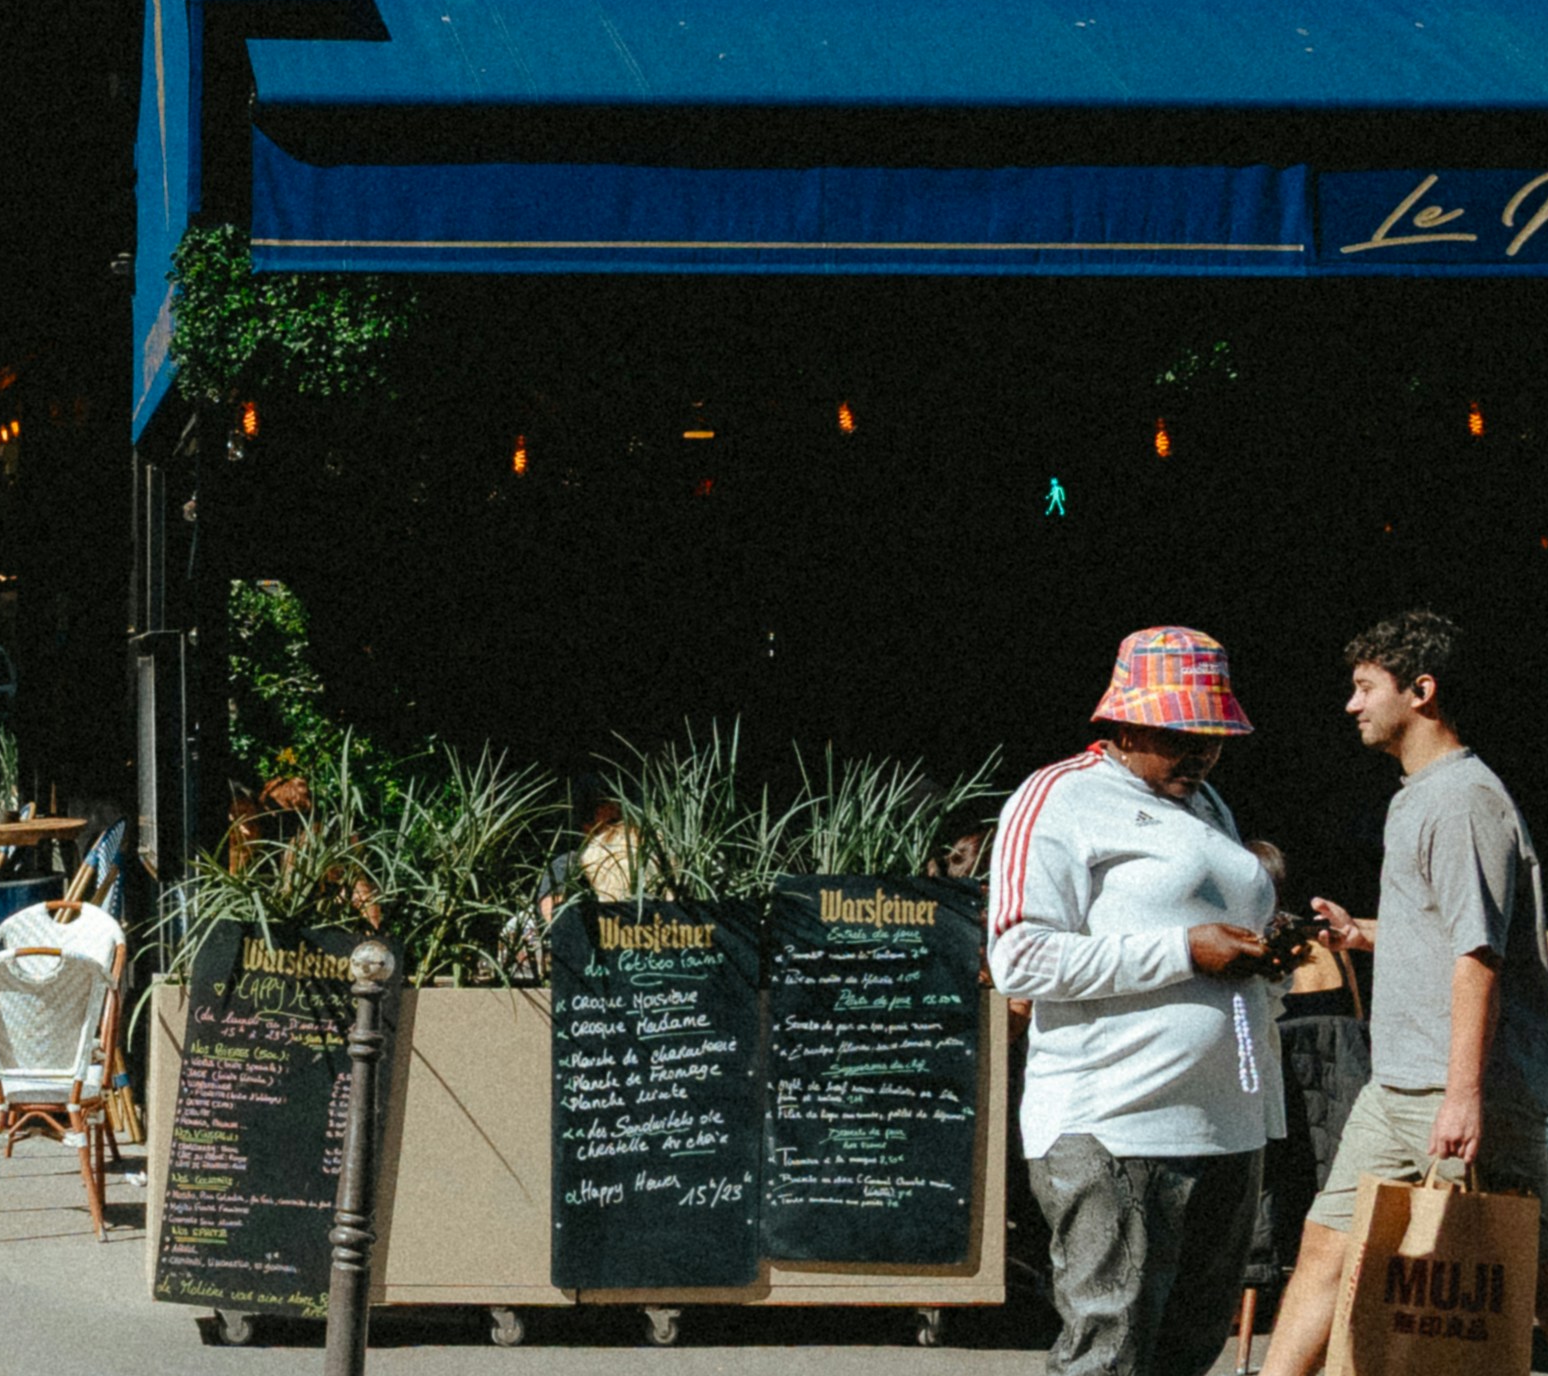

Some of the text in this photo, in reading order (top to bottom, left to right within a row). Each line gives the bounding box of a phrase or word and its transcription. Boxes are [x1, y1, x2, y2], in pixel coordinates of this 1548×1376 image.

[1339, 173, 1478, 255] Le
[819, 887, 939, 927] Warsteiner
[598, 912, 717, 953] Warsteiner
[242, 936, 356, 982] Warsteine
[580, 1178, 625, 1208] Happy
[1383, 1256, 1505, 1314] MUJI
